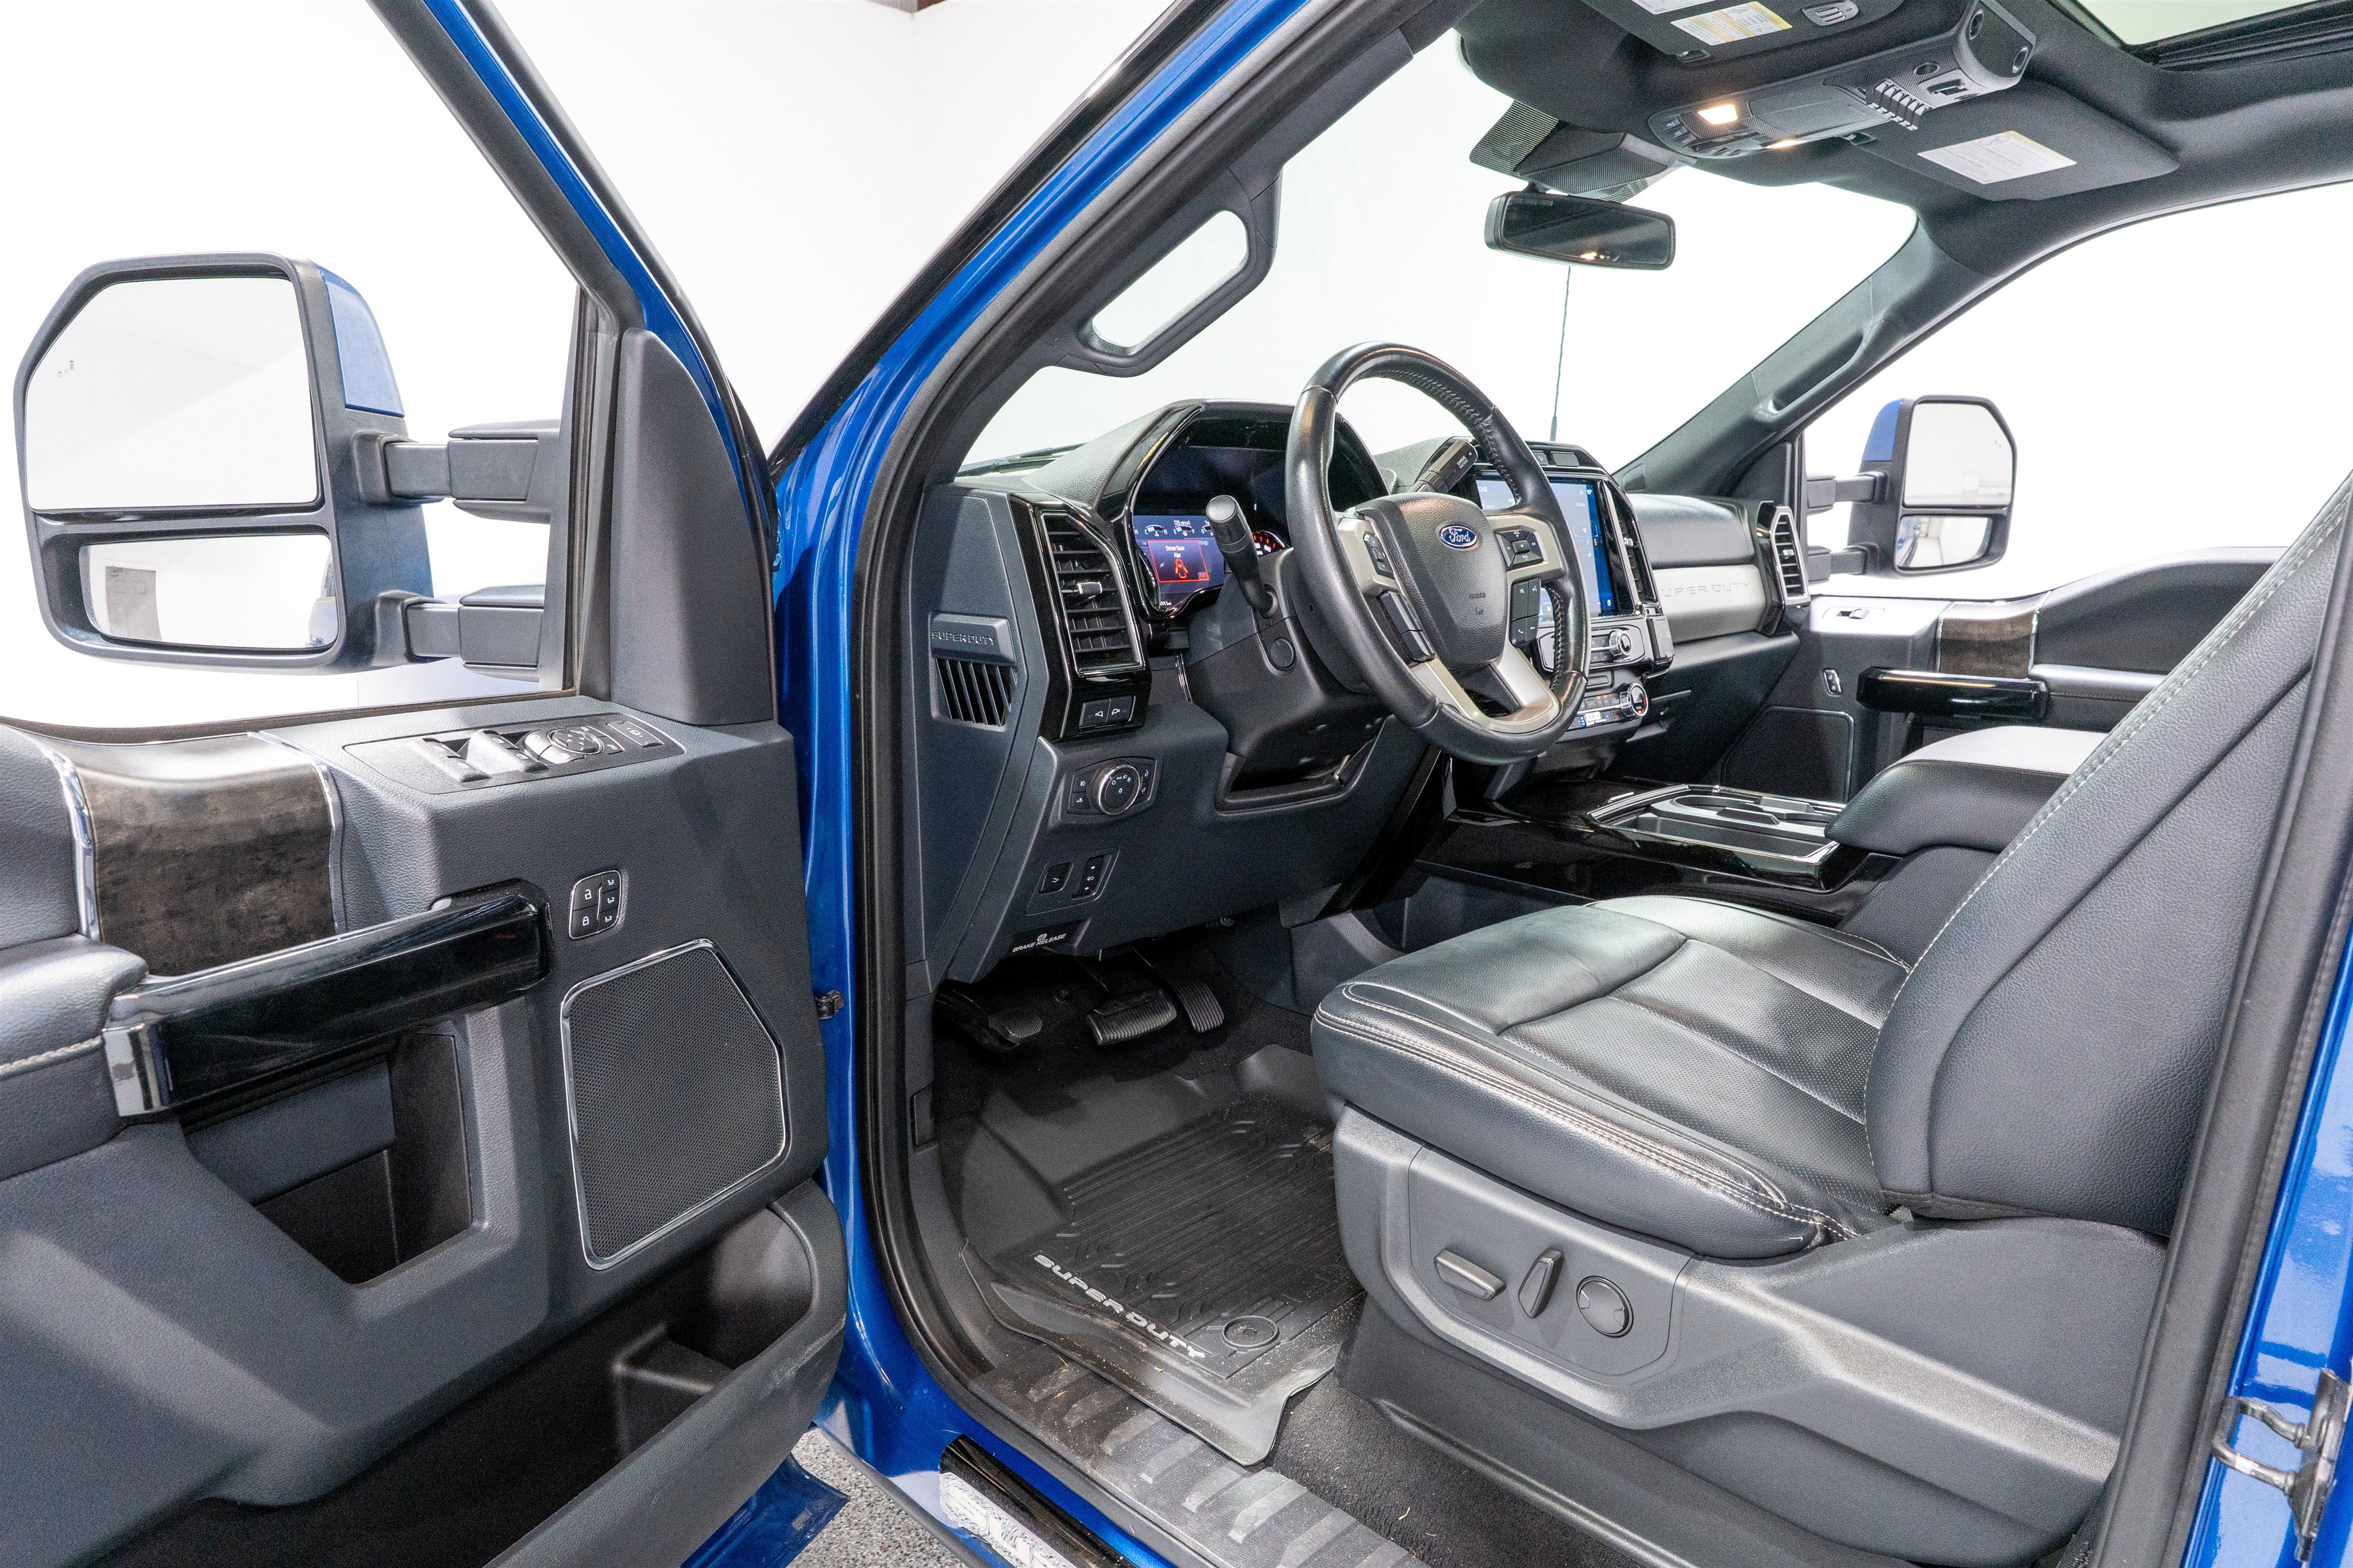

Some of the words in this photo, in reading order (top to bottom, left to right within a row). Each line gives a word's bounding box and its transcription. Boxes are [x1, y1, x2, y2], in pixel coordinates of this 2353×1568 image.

[1457, 455, 1467, 466] DRIVE
[1459, 459, 1469, 469] MODE
[1448, 528, 1471, 543] Ford
[1661, 586, 1708, 597] UPER
[1711, 582, 1752, 592] DUTY
[931, 632, 967, 642] SUPER
[968, 635, 995, 645] DUTY
[1012, 942, 1036, 953] BRAKE
[1036, 933, 1067, 946] RELEASE
[1034, 1254, 1124, 1314] SUPER
[1125, 1311, 1206, 1358] DUTY
